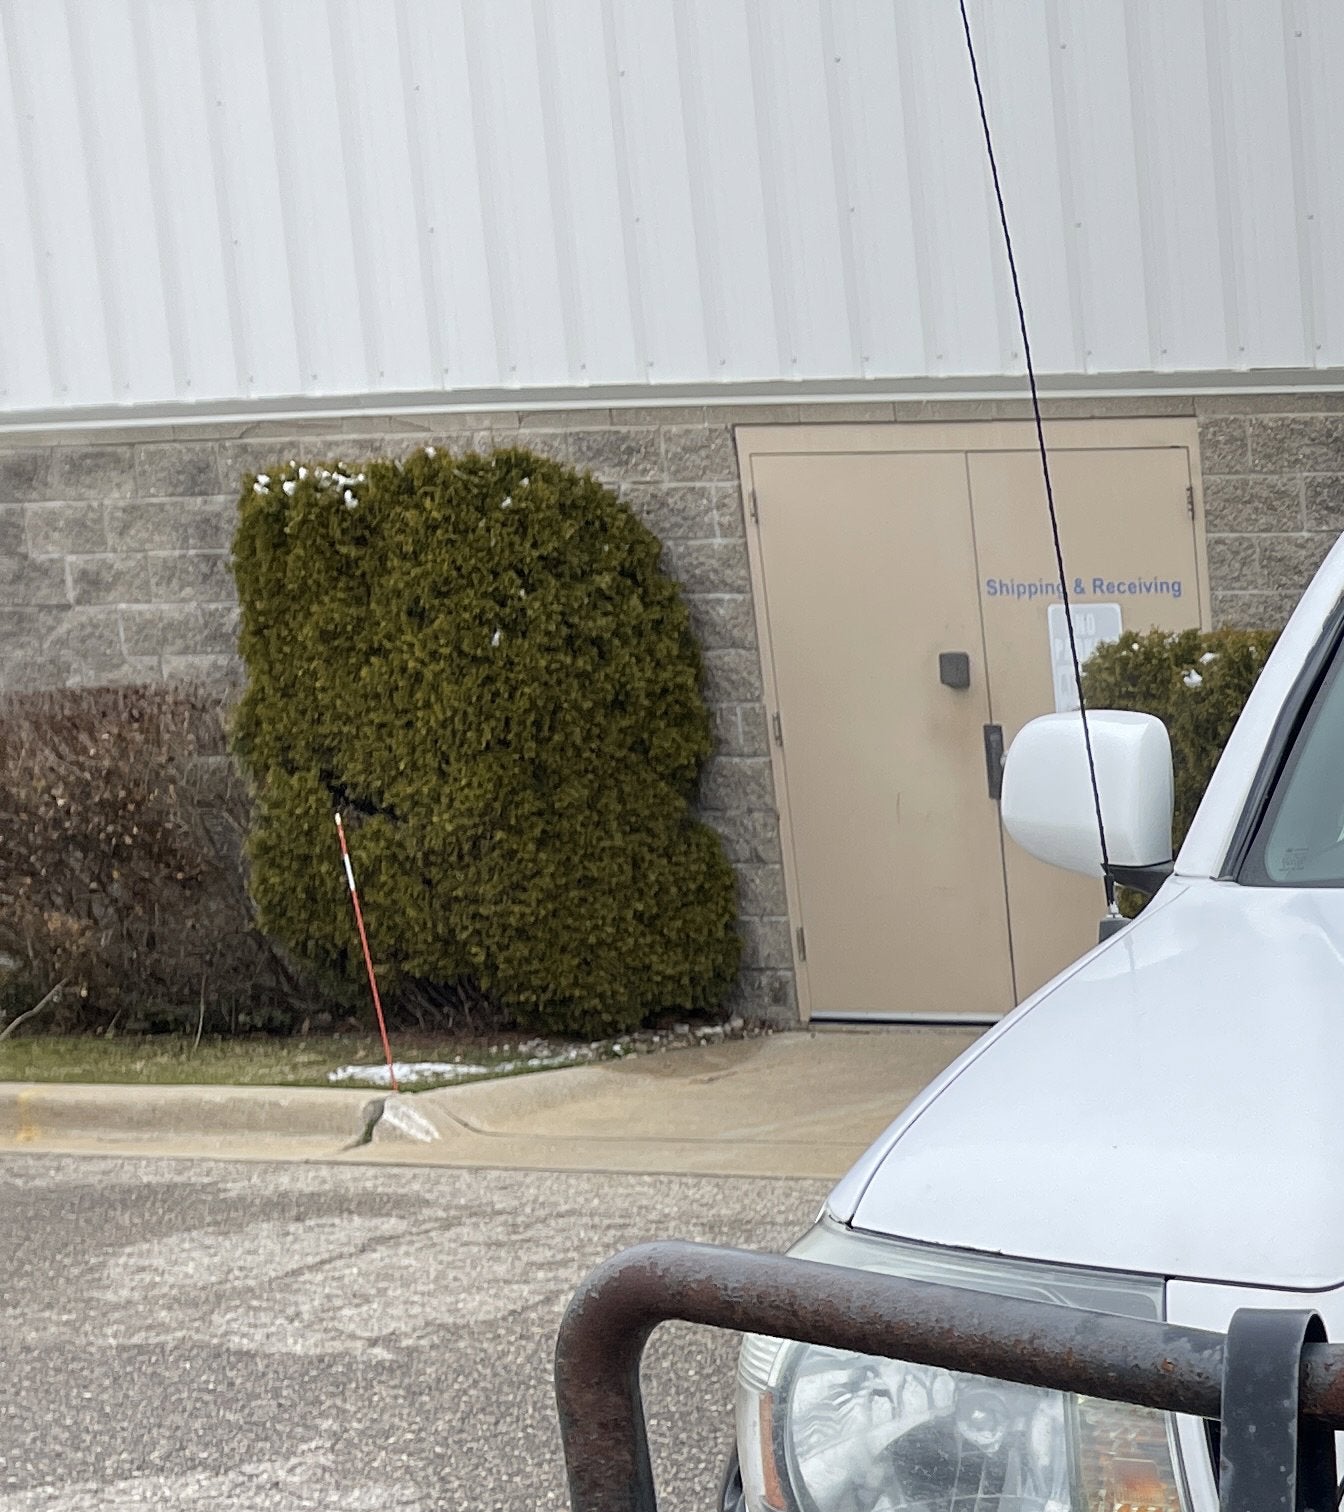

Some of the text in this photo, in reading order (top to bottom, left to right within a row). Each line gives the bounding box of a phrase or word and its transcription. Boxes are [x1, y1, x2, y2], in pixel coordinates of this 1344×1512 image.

[1073, 577, 1085, 595] &
[1092, 577, 1182, 598] Receiving
[1074, 612, 1097, 636] NO
